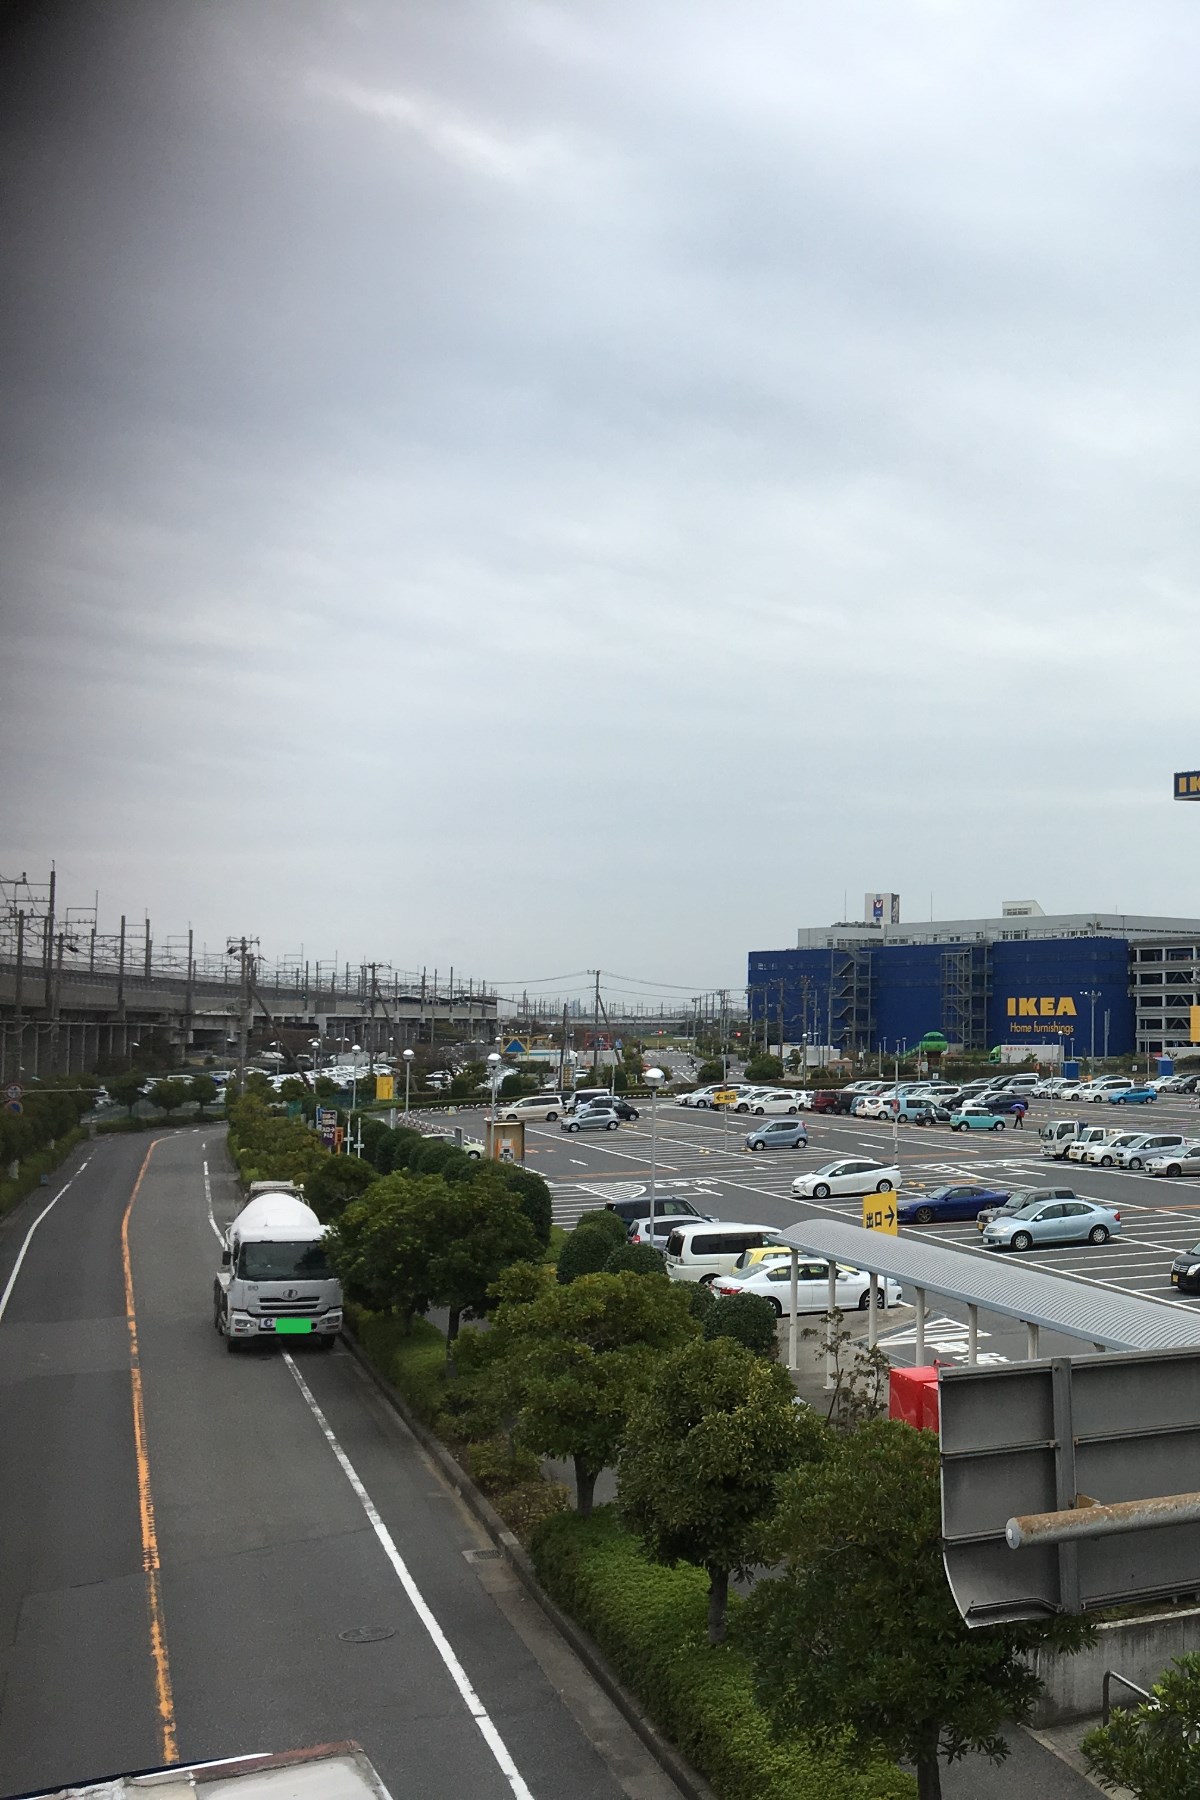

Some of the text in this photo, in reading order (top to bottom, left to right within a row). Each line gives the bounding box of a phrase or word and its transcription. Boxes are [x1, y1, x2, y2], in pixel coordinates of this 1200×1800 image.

[1007, 997, 1077, 1016] IKEA
[1010, 1021, 1074, 1035] Home furnishings
[866, 1211, 882, 1229] 出口
